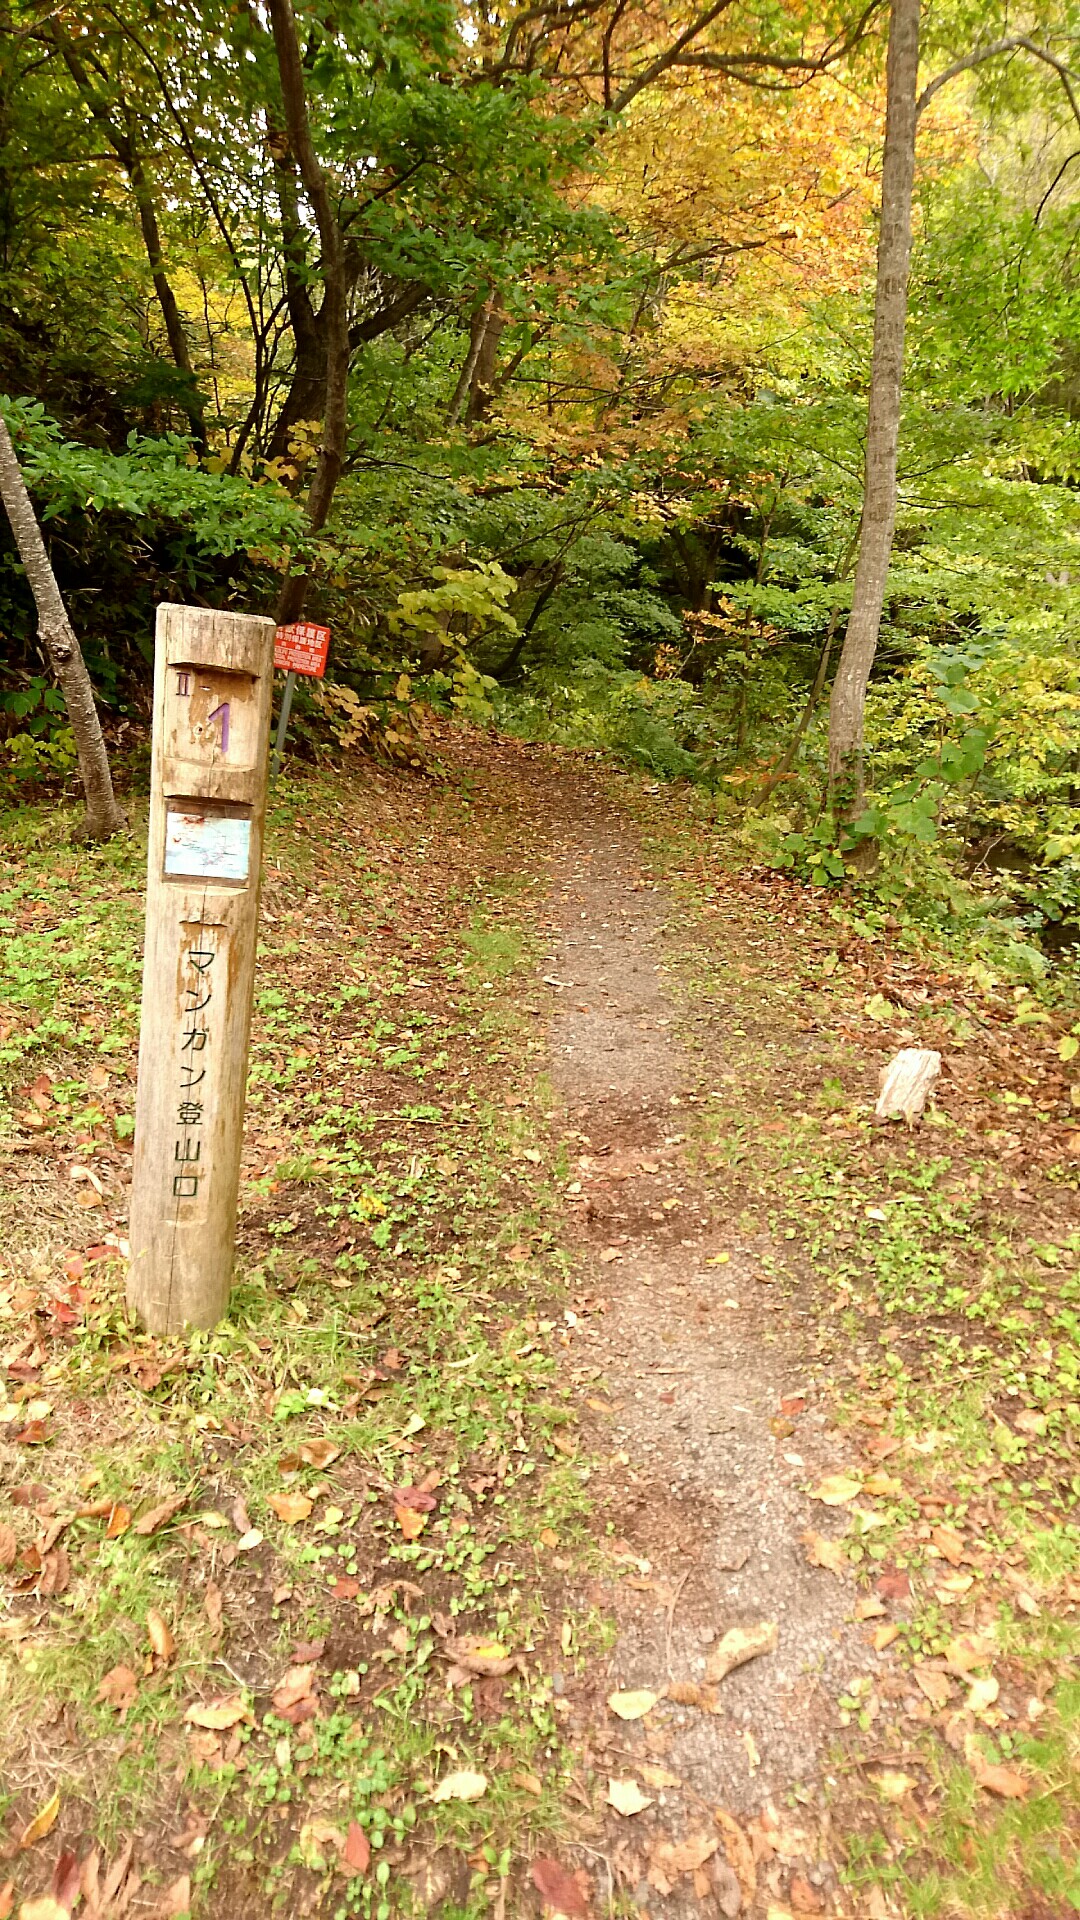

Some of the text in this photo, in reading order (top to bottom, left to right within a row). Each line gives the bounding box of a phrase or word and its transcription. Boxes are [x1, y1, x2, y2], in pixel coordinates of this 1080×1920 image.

[208, 702, 230, 753] 1
[173, 950, 215, 1197] マンガン登山口
